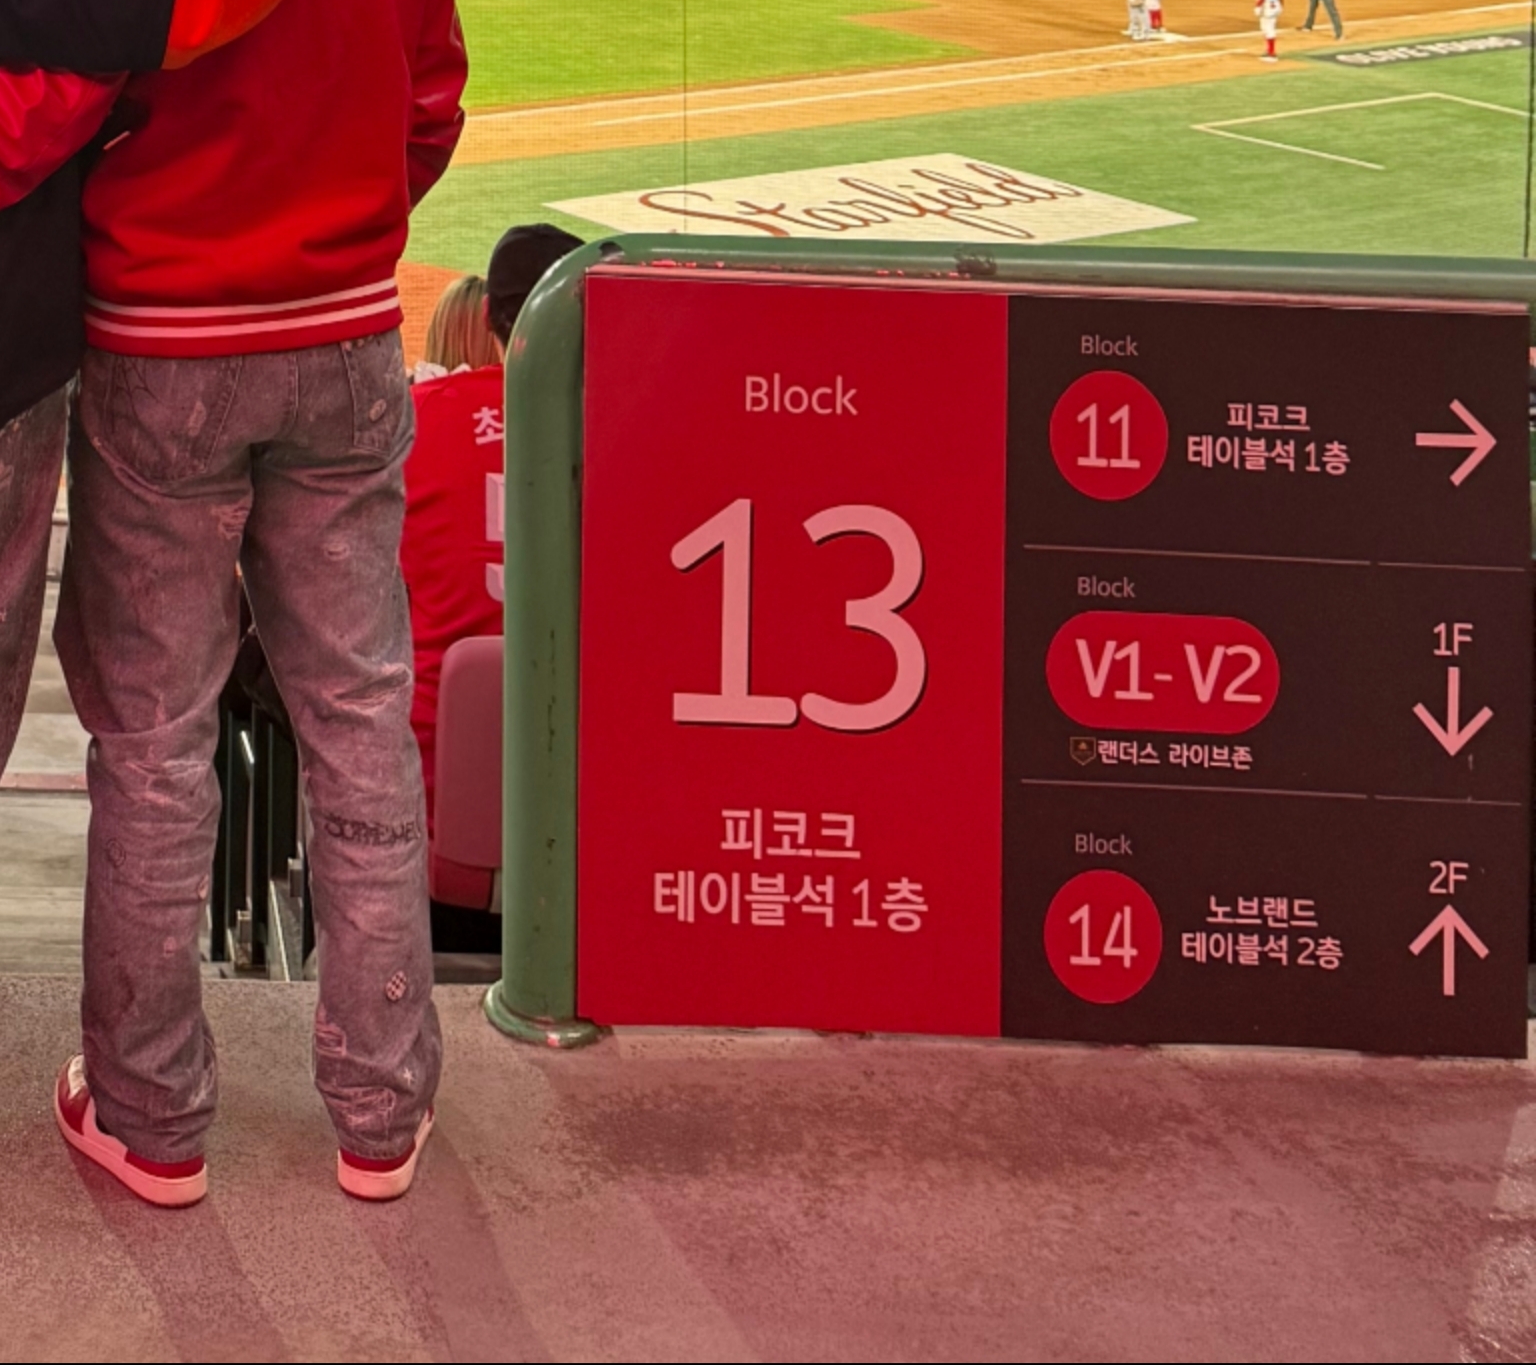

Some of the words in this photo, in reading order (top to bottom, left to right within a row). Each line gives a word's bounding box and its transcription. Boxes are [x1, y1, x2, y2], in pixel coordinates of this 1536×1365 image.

[638, 161, 1084, 239] Starfield
[1080, 334, 1139, 357] Block
[745, 373, 859, 416] Block
[1075, 402, 1142, 469] 11
[1226, 402, 1312, 432] 피코크
[1186, 435, 1297, 472] 테이블석
[1304, 441, 1351, 475] 1층
[1076, 575, 1136, 599] Block
[670, 498, 929, 733] 13
[1432, 621, 1474, 657] 1F
[1097, 739, 1161, 766] 랜더스
[1168, 742, 1254, 771] 라이브존
[720, 807, 862, 860] 피코크
[1074, 831, 1133, 857] Block
[1428, 861, 1470, 895] 2F
[652, 870, 836, 928] 테이블석
[851, 876, 930, 933] 1층
[1205, 894, 1319, 929] 노브랜드
[1067, 903, 1140, 970] 14
[1181, 931, 1289, 967] 테이블석
[1296, 936, 1344, 970] 2층
